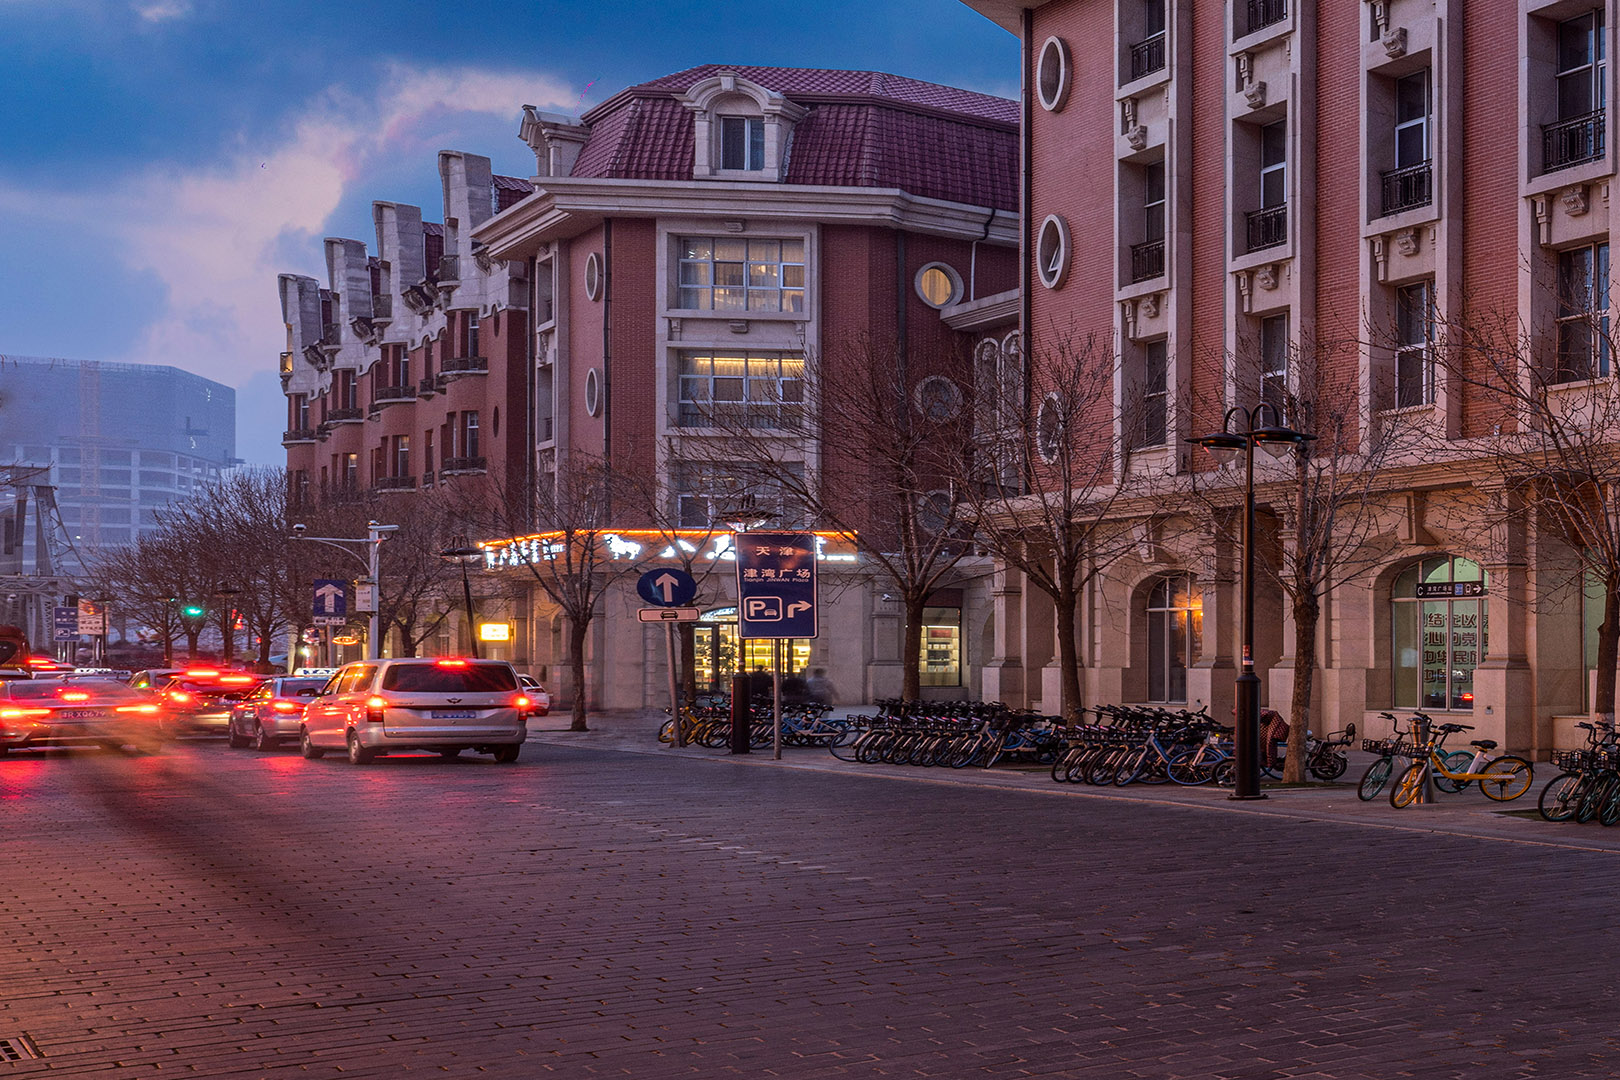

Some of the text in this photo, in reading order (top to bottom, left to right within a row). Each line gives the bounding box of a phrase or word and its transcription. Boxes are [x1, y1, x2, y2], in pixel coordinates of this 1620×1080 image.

[755, 546, 794, 556] 天津
[743, 568, 811, 578] 津湾广场
[749, 601, 766, 617] P
